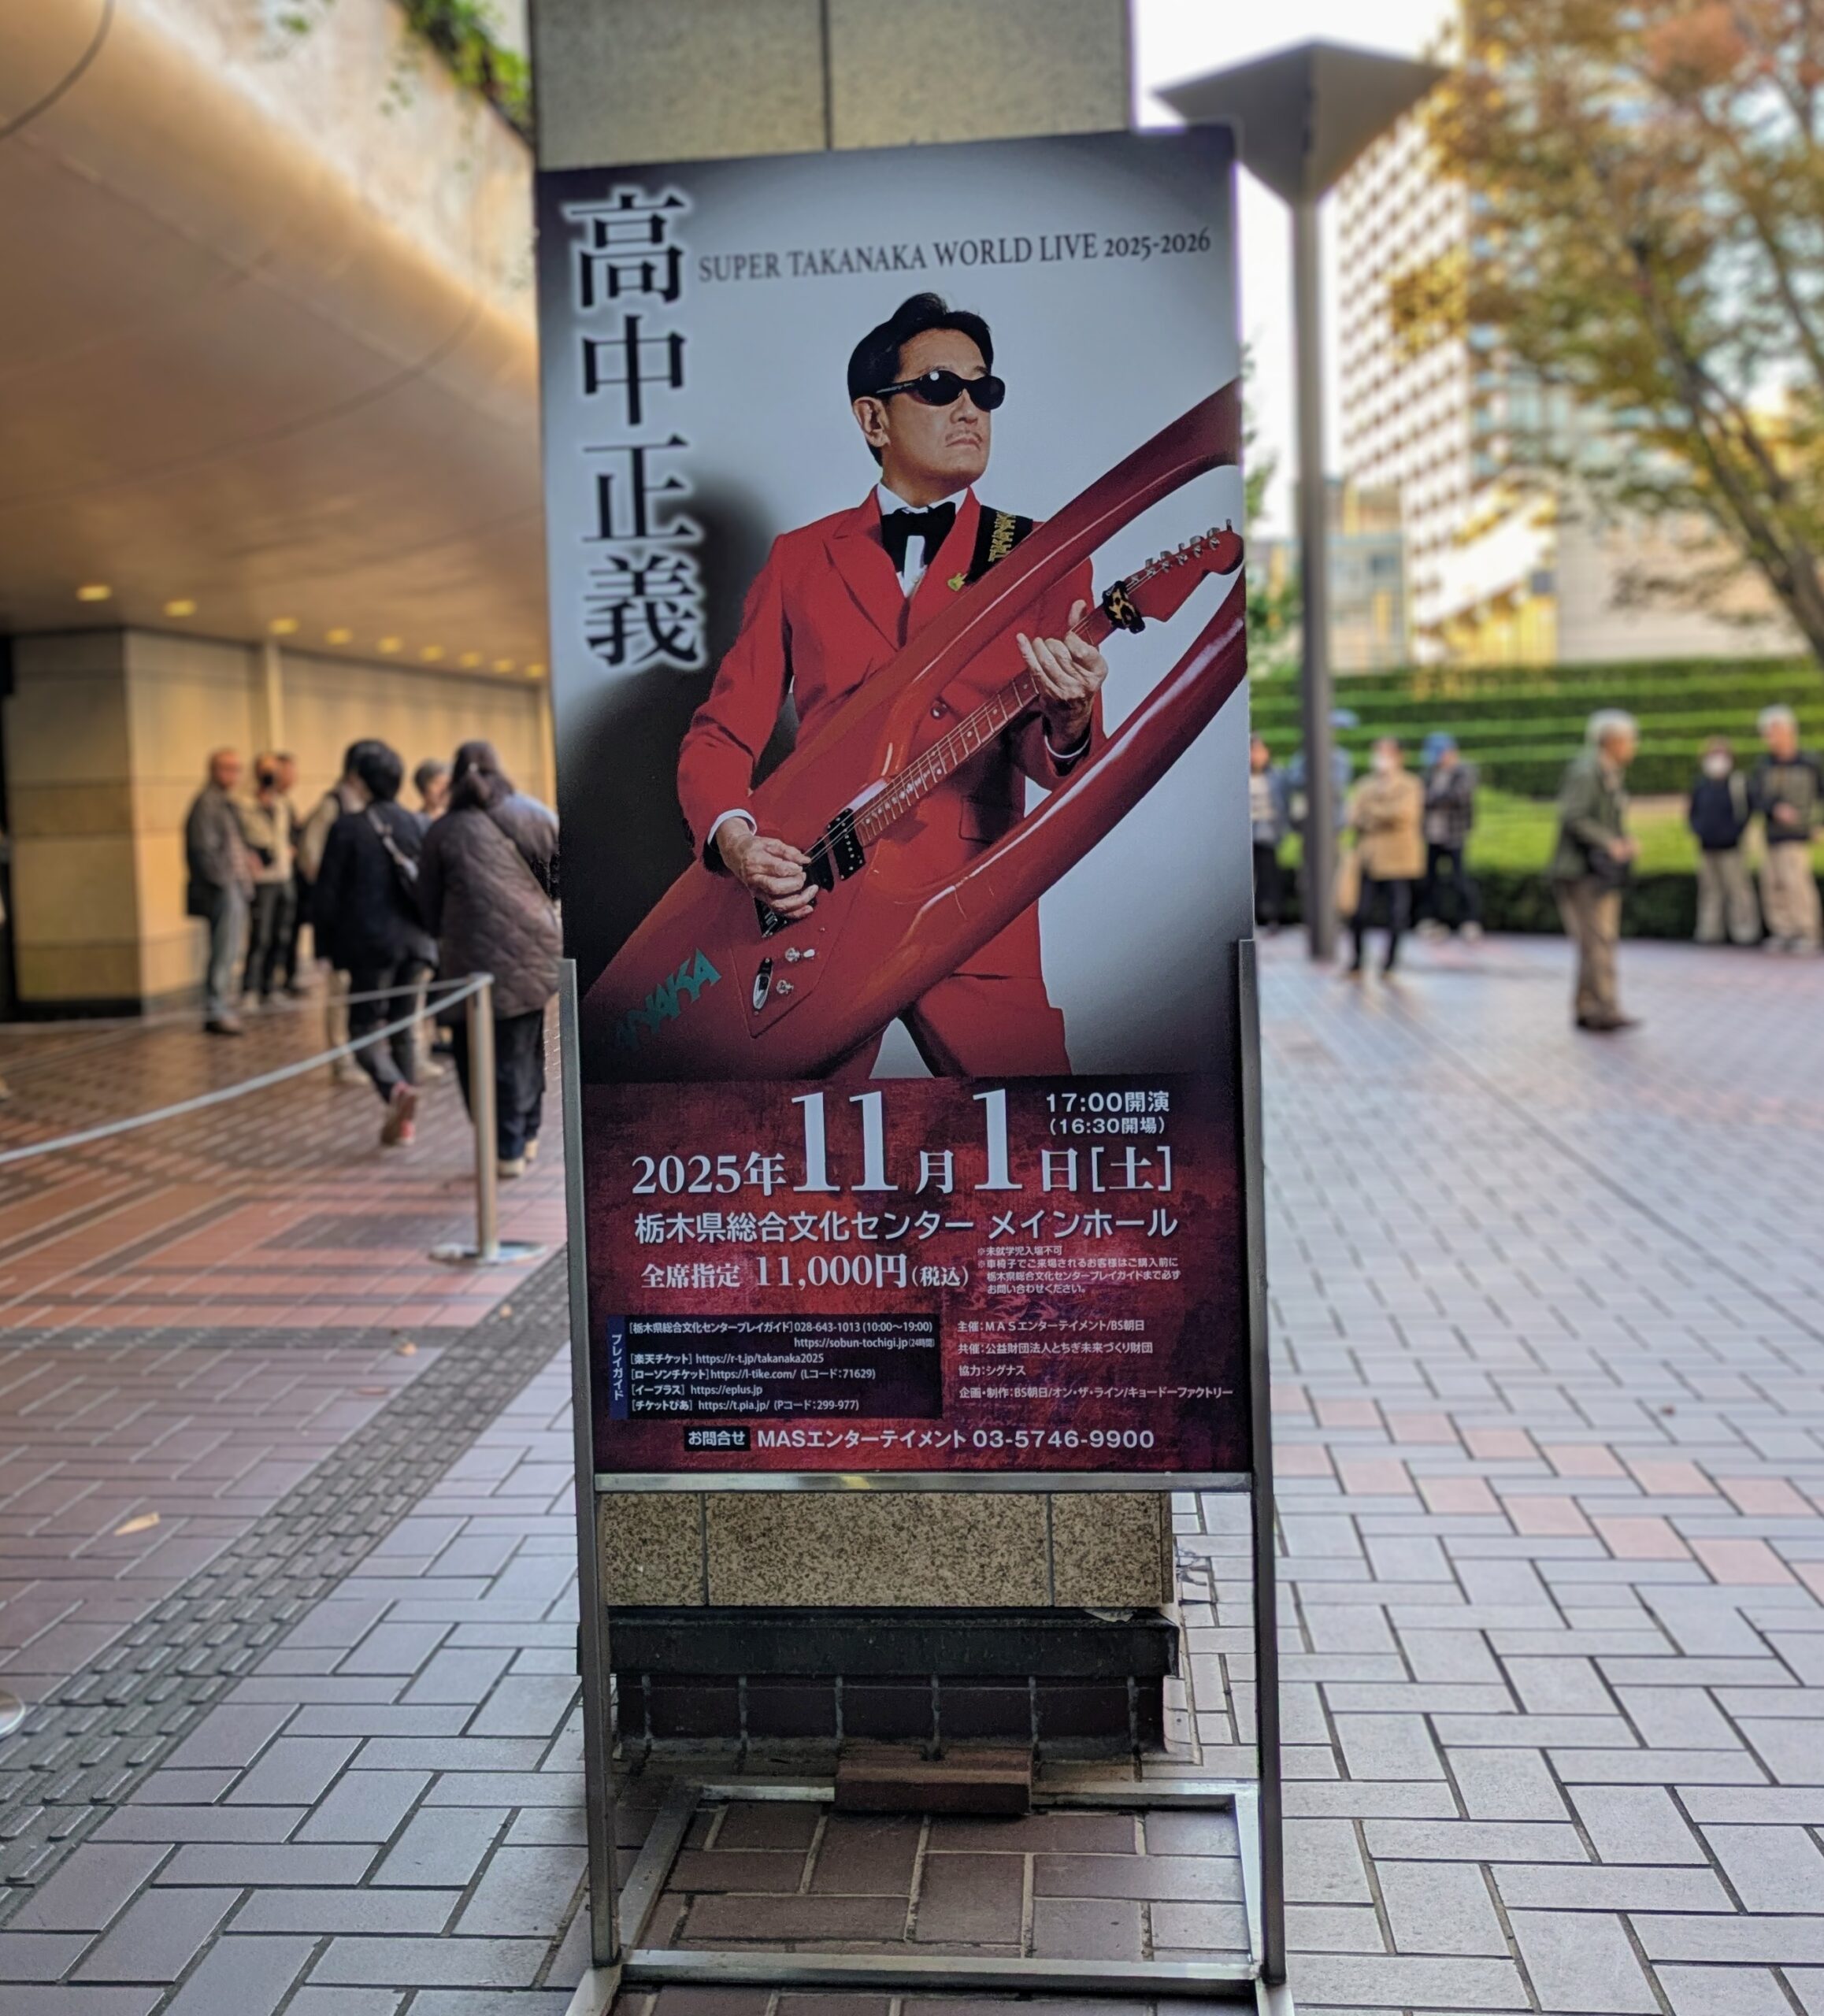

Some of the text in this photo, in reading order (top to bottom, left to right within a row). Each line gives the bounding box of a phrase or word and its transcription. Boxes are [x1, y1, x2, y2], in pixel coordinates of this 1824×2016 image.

[698, 226, 1213, 284] SUPER TAKANAKA WORLD LIVE 2025-2026
[567, 192, 704, 666] 高中正義
[1044, 1090, 1172, 1115] 17:00開演
[1048, 1116, 1167, 1136] (16:30開場)
[633, 1207, 1180, 1244] 栃木県総合文化センター メインホール
[640, 1264, 740, 1290] 全席指定
[611, 1334, 625, 1401] プレイガイド
[690, 1384, 763, 1396] https://eplus.jp
[688, 1428, 1155, 1449] お問合せ MASエンターテイメント 03-5746-9900
